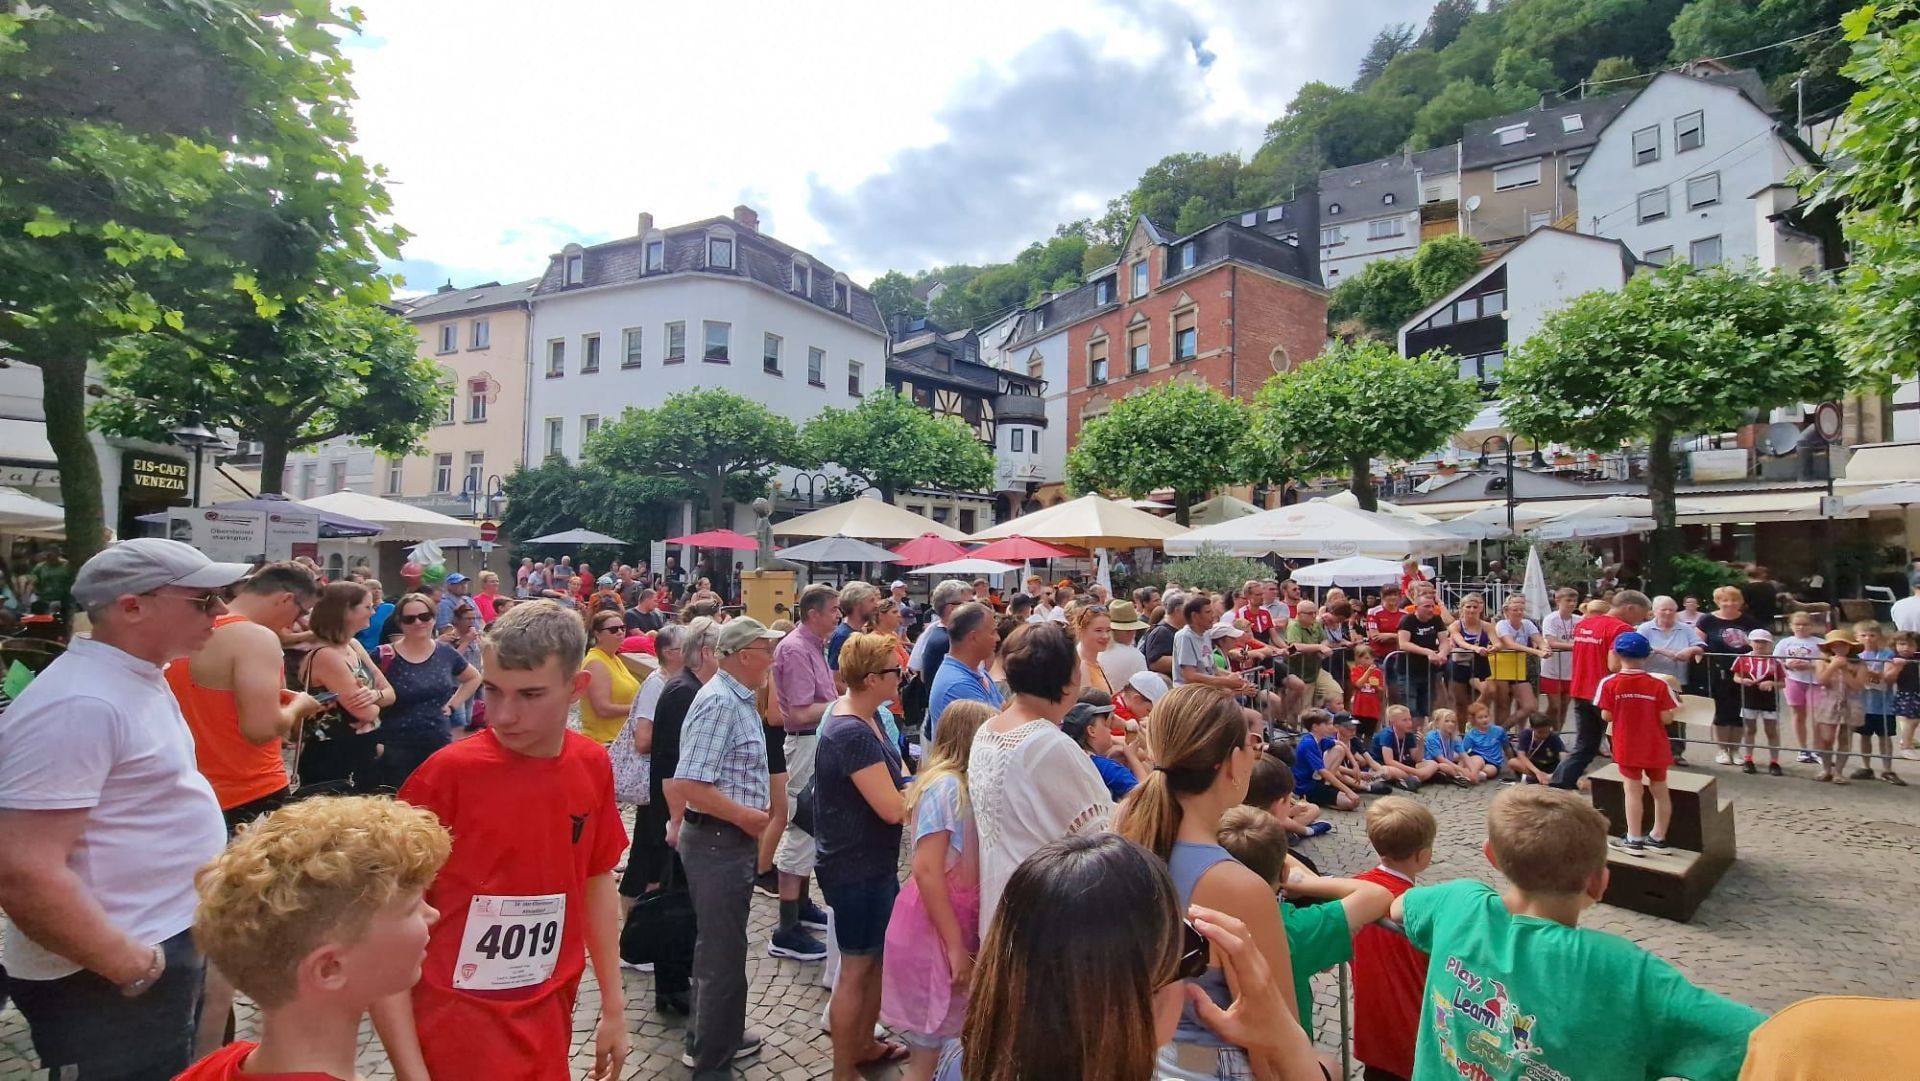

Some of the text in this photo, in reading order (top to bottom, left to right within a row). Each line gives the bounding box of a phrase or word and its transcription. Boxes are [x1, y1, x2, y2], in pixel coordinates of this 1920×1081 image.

[0, 468, 60, 487] afe
[133, 459, 186, 477] EIS-CAFE
[134, 473, 185, 490] VENEZIA
[475, 920, 558, 961] 4019
[1445, 955, 1482, 993] Play.
[1453, 986, 1498, 1029] Learn
